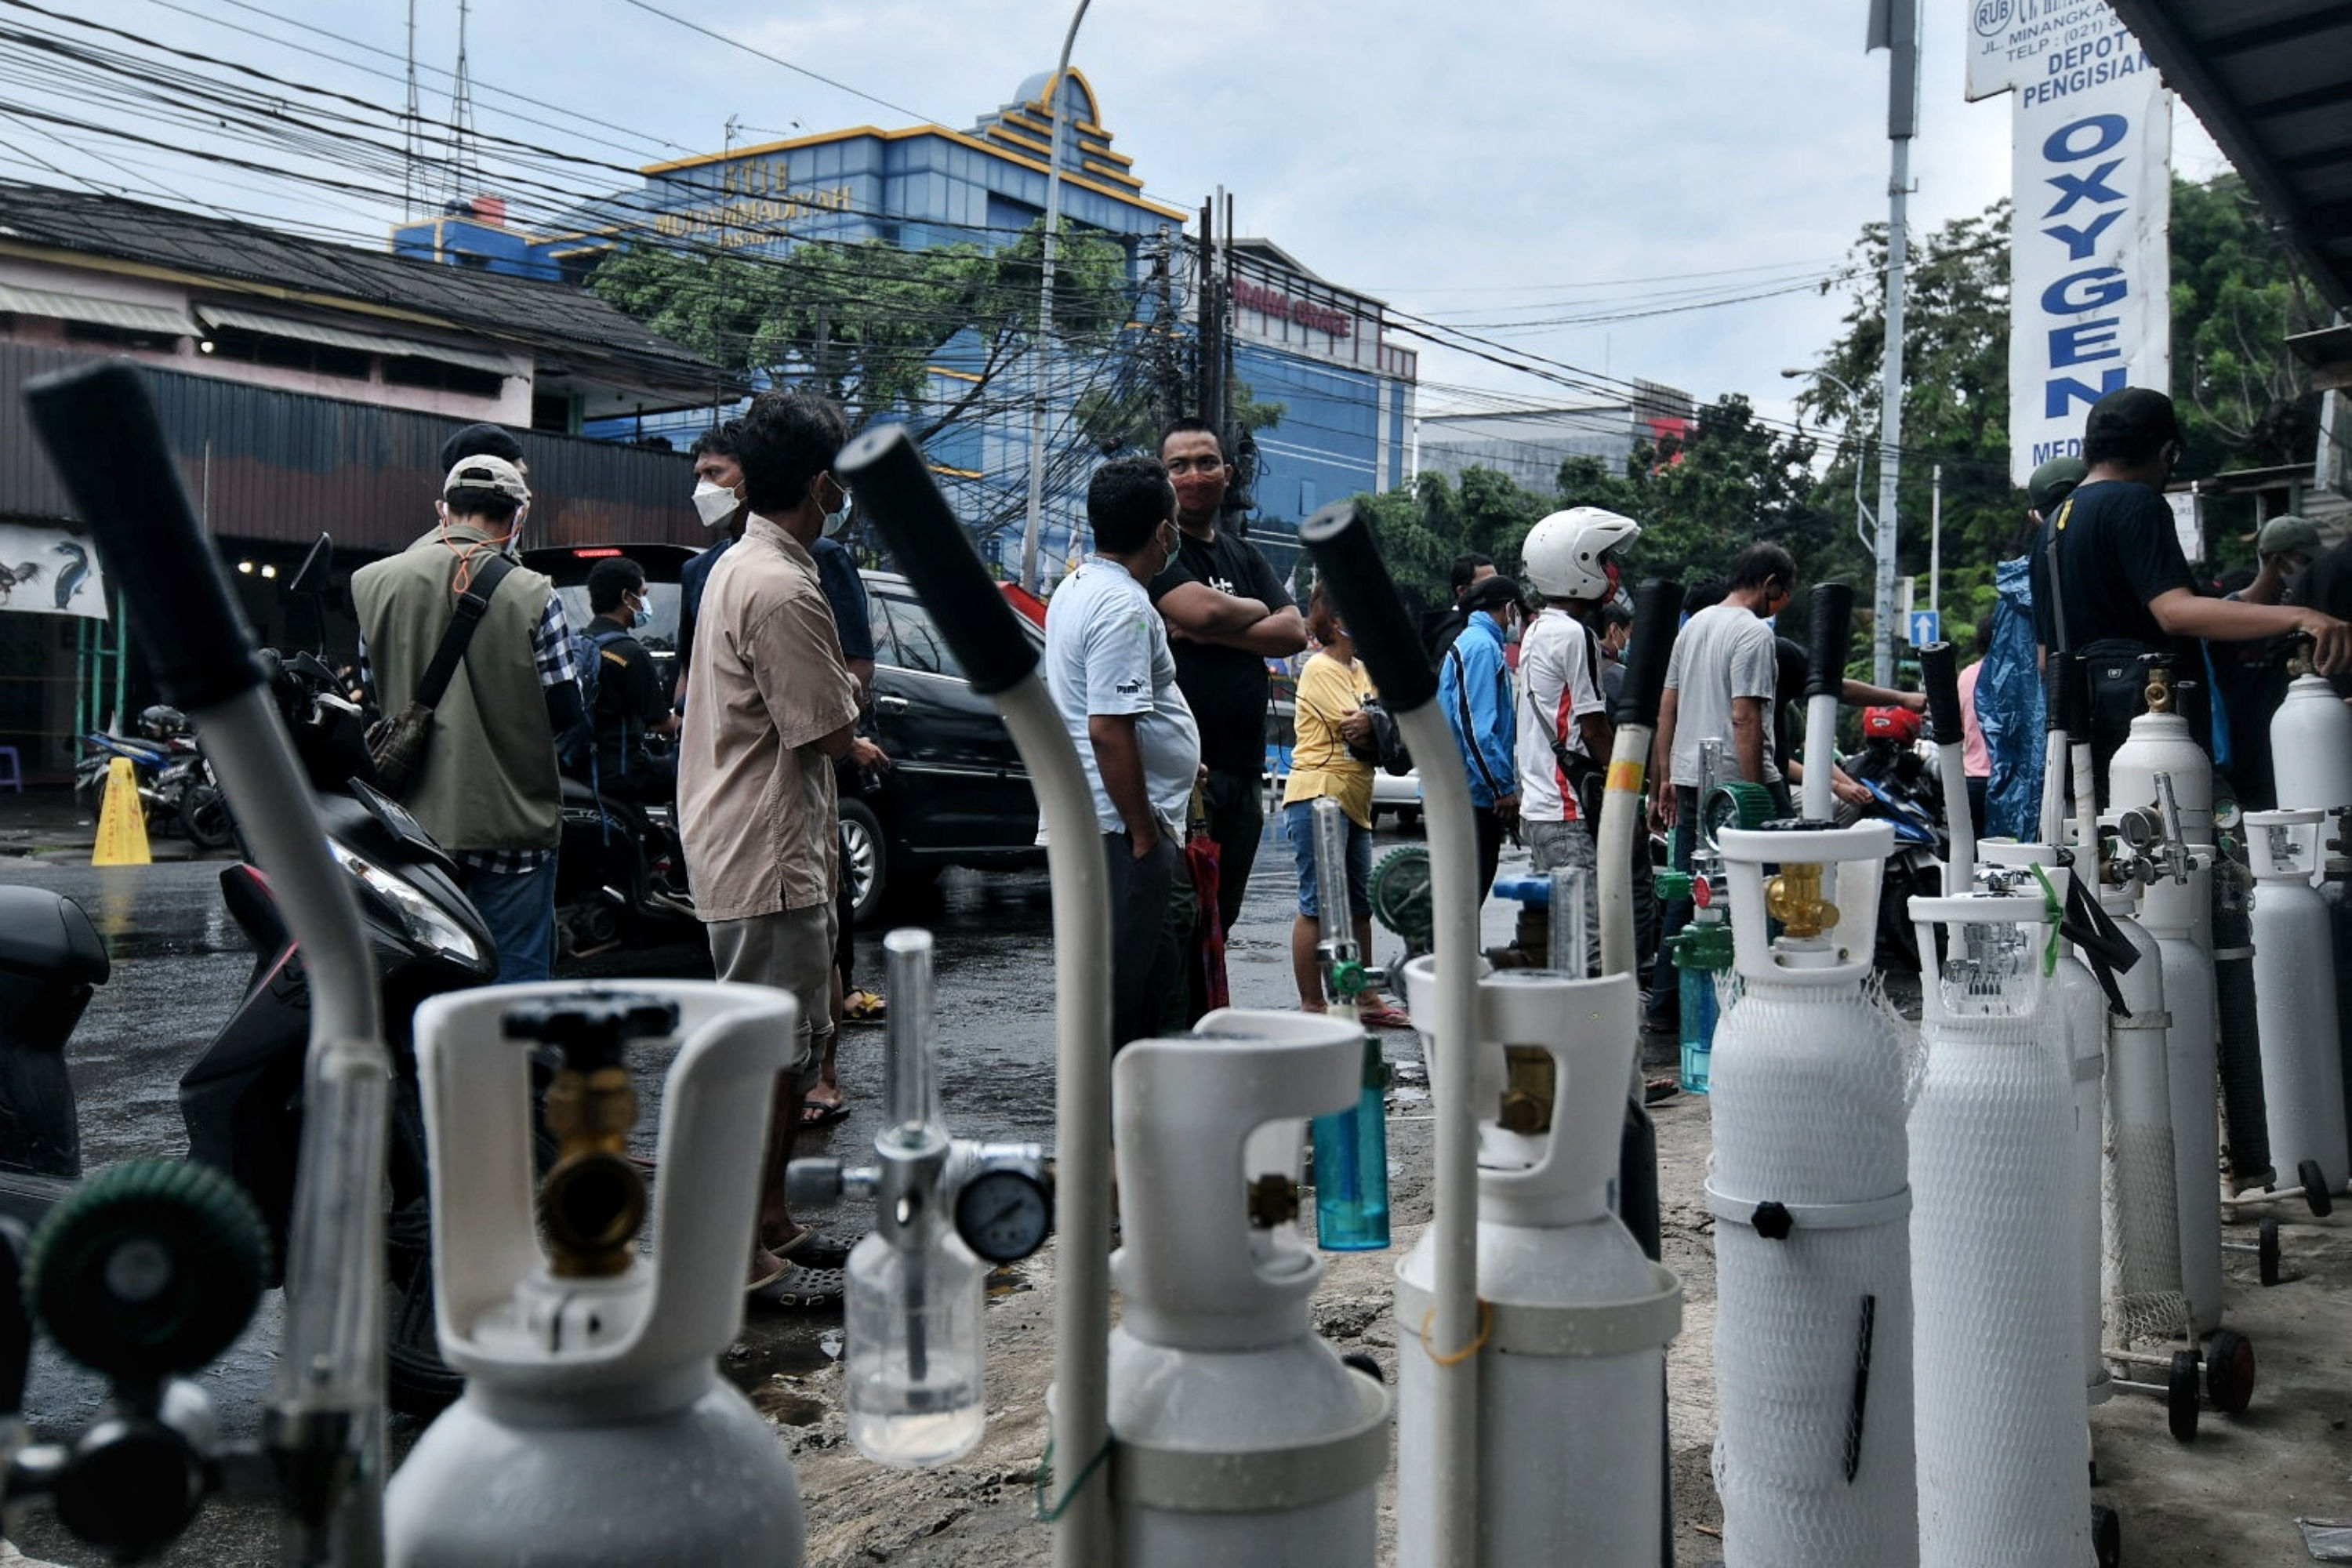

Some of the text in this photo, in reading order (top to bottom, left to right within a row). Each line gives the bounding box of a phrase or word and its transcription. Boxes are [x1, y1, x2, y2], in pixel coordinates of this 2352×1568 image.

[1979, 0, 2009, 27] RUB
[1981, 42, 2002, 56] JL.
[2009, 2, 2107, 45] MINANGKA
[2007, 38, 2049, 62] TELP
[2063, 20, 2103, 45] (021)
[2049, 30, 2128, 74] DEPOT
[2041, 114, 2129, 419] OXYGEN
[2033, 438, 2085, 466] MED
